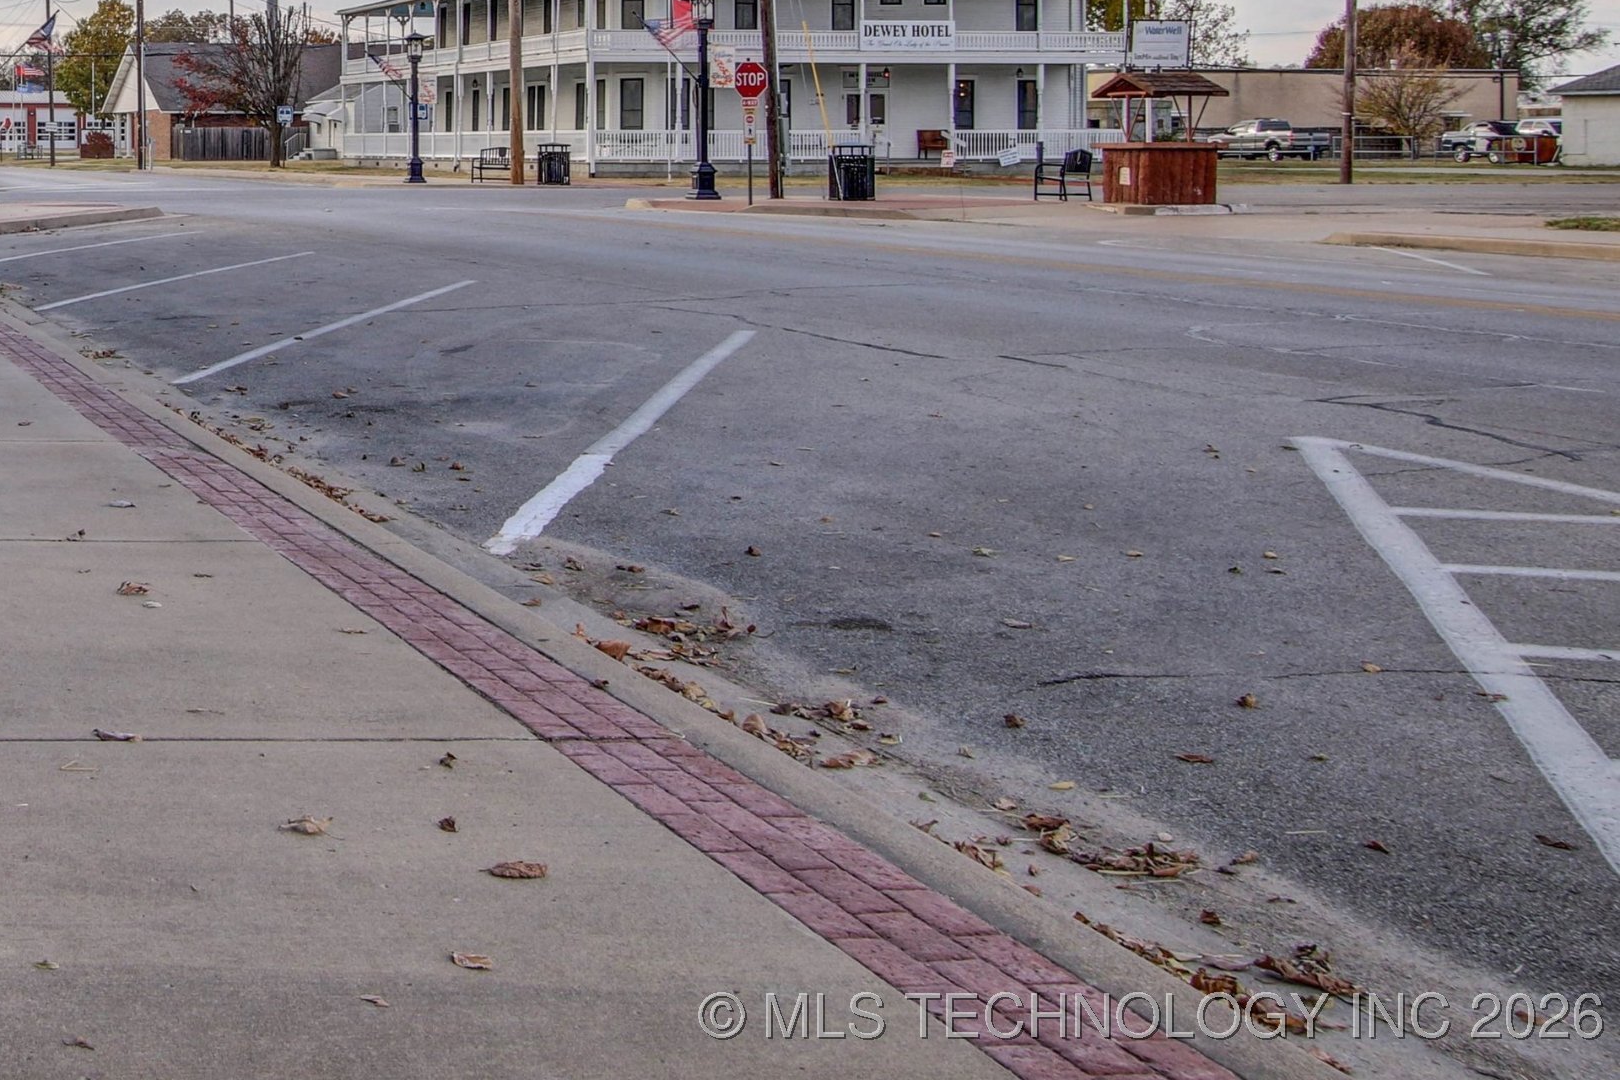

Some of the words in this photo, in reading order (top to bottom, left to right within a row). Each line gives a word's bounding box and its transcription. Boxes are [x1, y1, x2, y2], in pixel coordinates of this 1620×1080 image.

[863, 24, 908, 37] DEWEY
[912, 24, 952, 37] HOTEL
[736, 72, 765, 87] STOP
